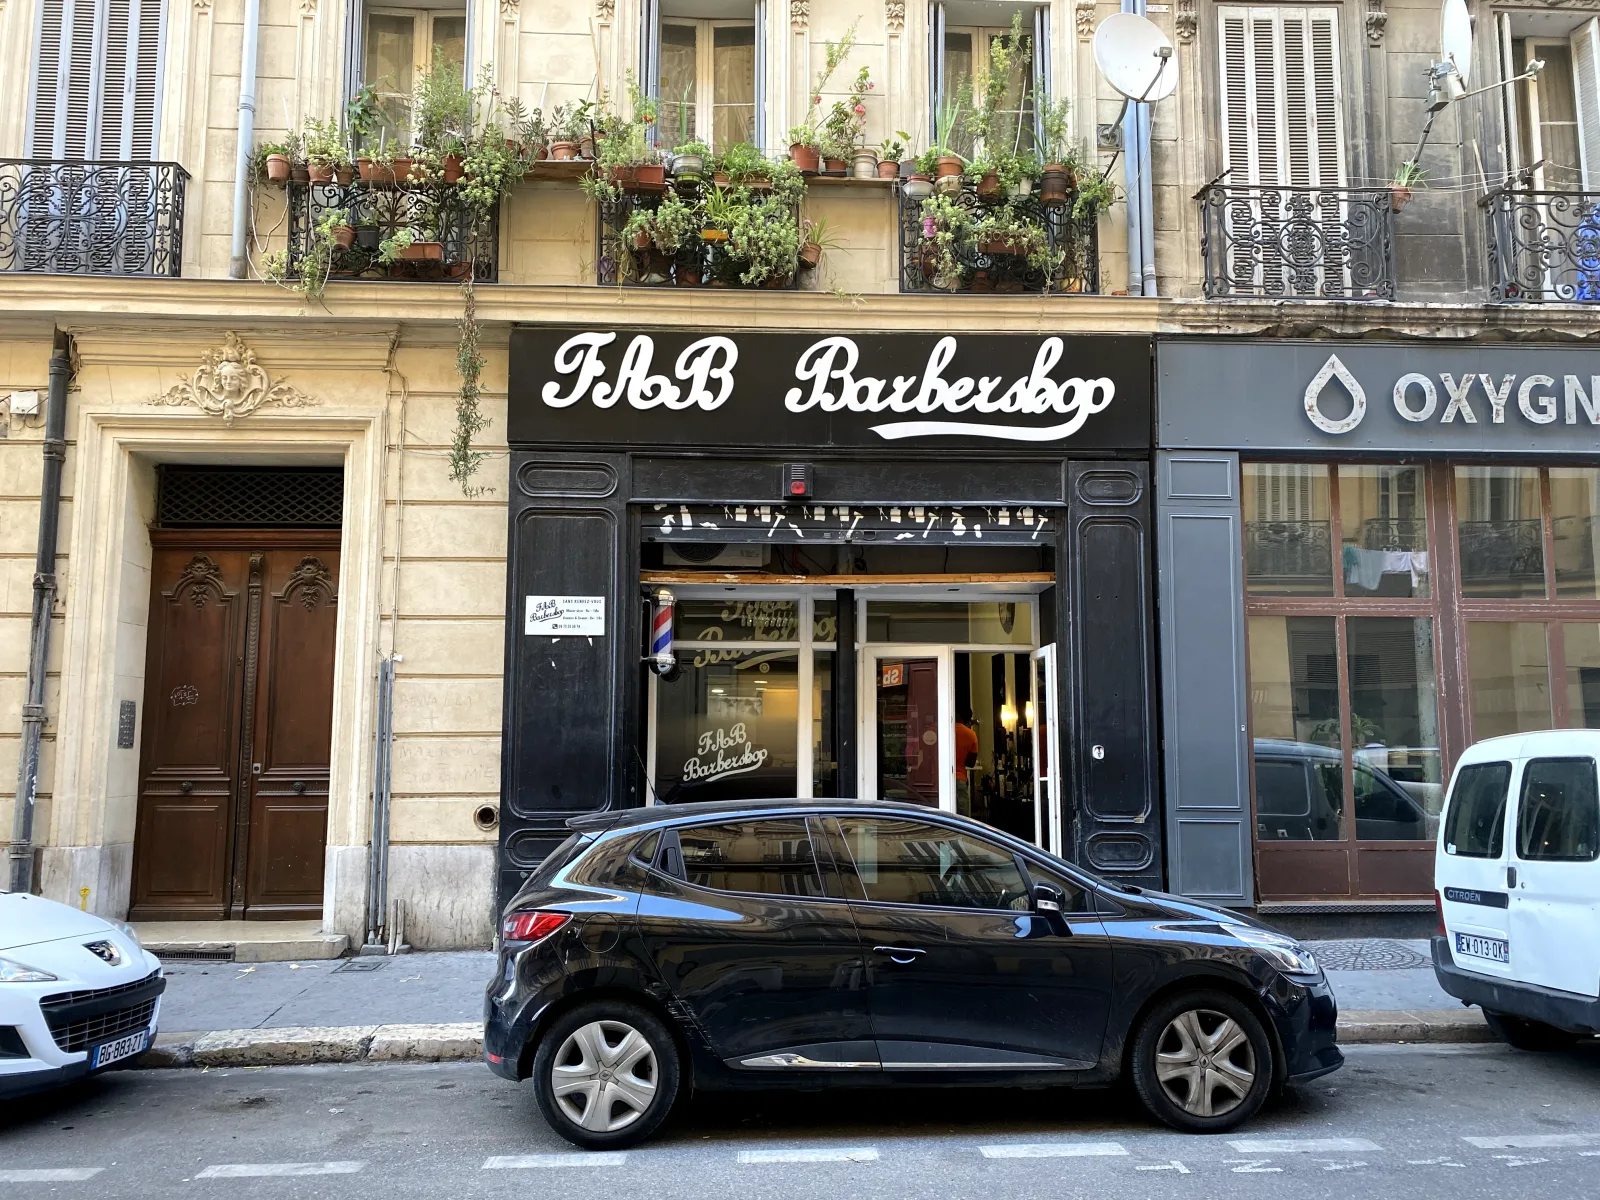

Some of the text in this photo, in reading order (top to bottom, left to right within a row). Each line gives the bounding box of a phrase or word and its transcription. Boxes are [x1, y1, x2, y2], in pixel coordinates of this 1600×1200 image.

[784, 336, 1116, 442] Barbershop
[683, 742, 768, 782] Barbershop
[1447, 889, 1481, 902] CITROËN
